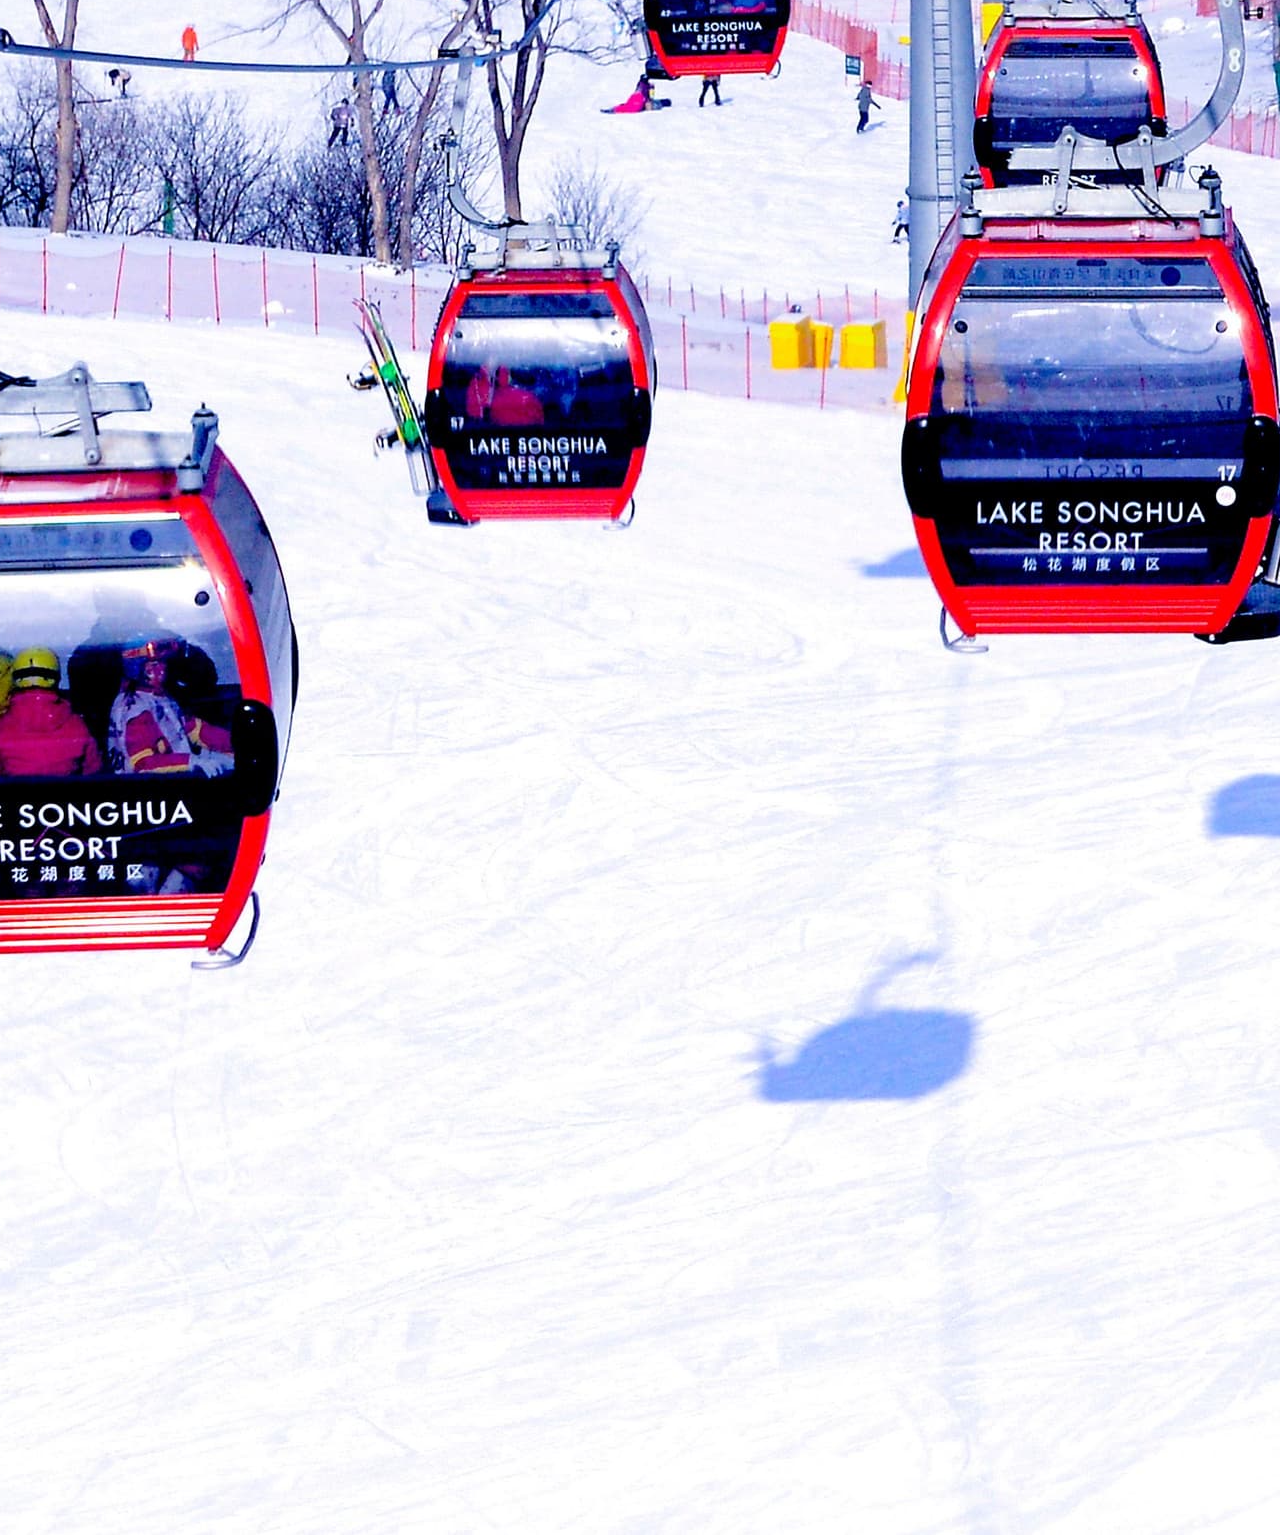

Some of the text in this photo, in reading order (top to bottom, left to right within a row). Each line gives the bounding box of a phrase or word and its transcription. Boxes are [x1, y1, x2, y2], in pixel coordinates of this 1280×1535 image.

[672, 21, 763, 33] LAKE SONGHUA
[697, 33, 739, 43] RESORT
[470, 436, 607, 455] LAKE SONGHUA
[507, 455, 570, 472] RESORT
[1217, 465, 1237, 481] 17
[976, 500, 1206, 524] LAKE SONGHUA
[1039, 532, 1144, 552] RESORT
[1022, 556, 1161, 572] 松花湖度假区
[18, 799, 194, 828] SONGHUA
[0, 836, 122, 863] RESORT
